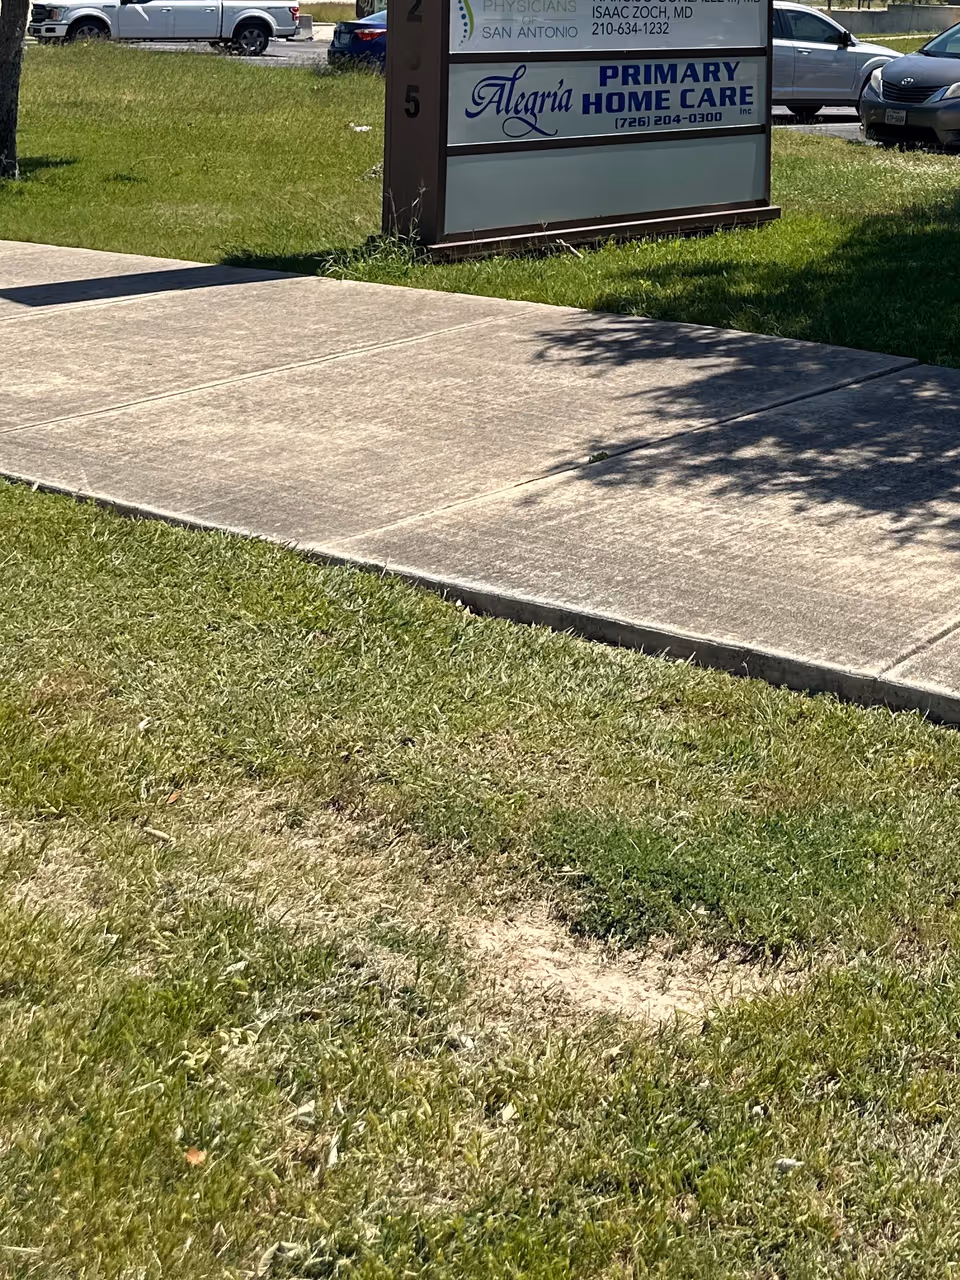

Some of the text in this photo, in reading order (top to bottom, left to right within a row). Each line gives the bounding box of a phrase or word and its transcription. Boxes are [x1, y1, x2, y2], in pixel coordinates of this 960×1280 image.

[483, 0, 577, 13] PHYSICIANS
[592, 6, 693, 20] ISAAC ZOCH, MD
[522, 16, 538, 26] OF
[482, 26, 578, 39] SAN ANTONIO
[592, 22, 670, 35] 210-634-1232
[599, 61, 740, 87] PRIMARY
[582, 86, 754, 115] HOME CARE
[739, 107, 752, 115] Inc
[615, 112, 722, 129] (726) 204-0300
